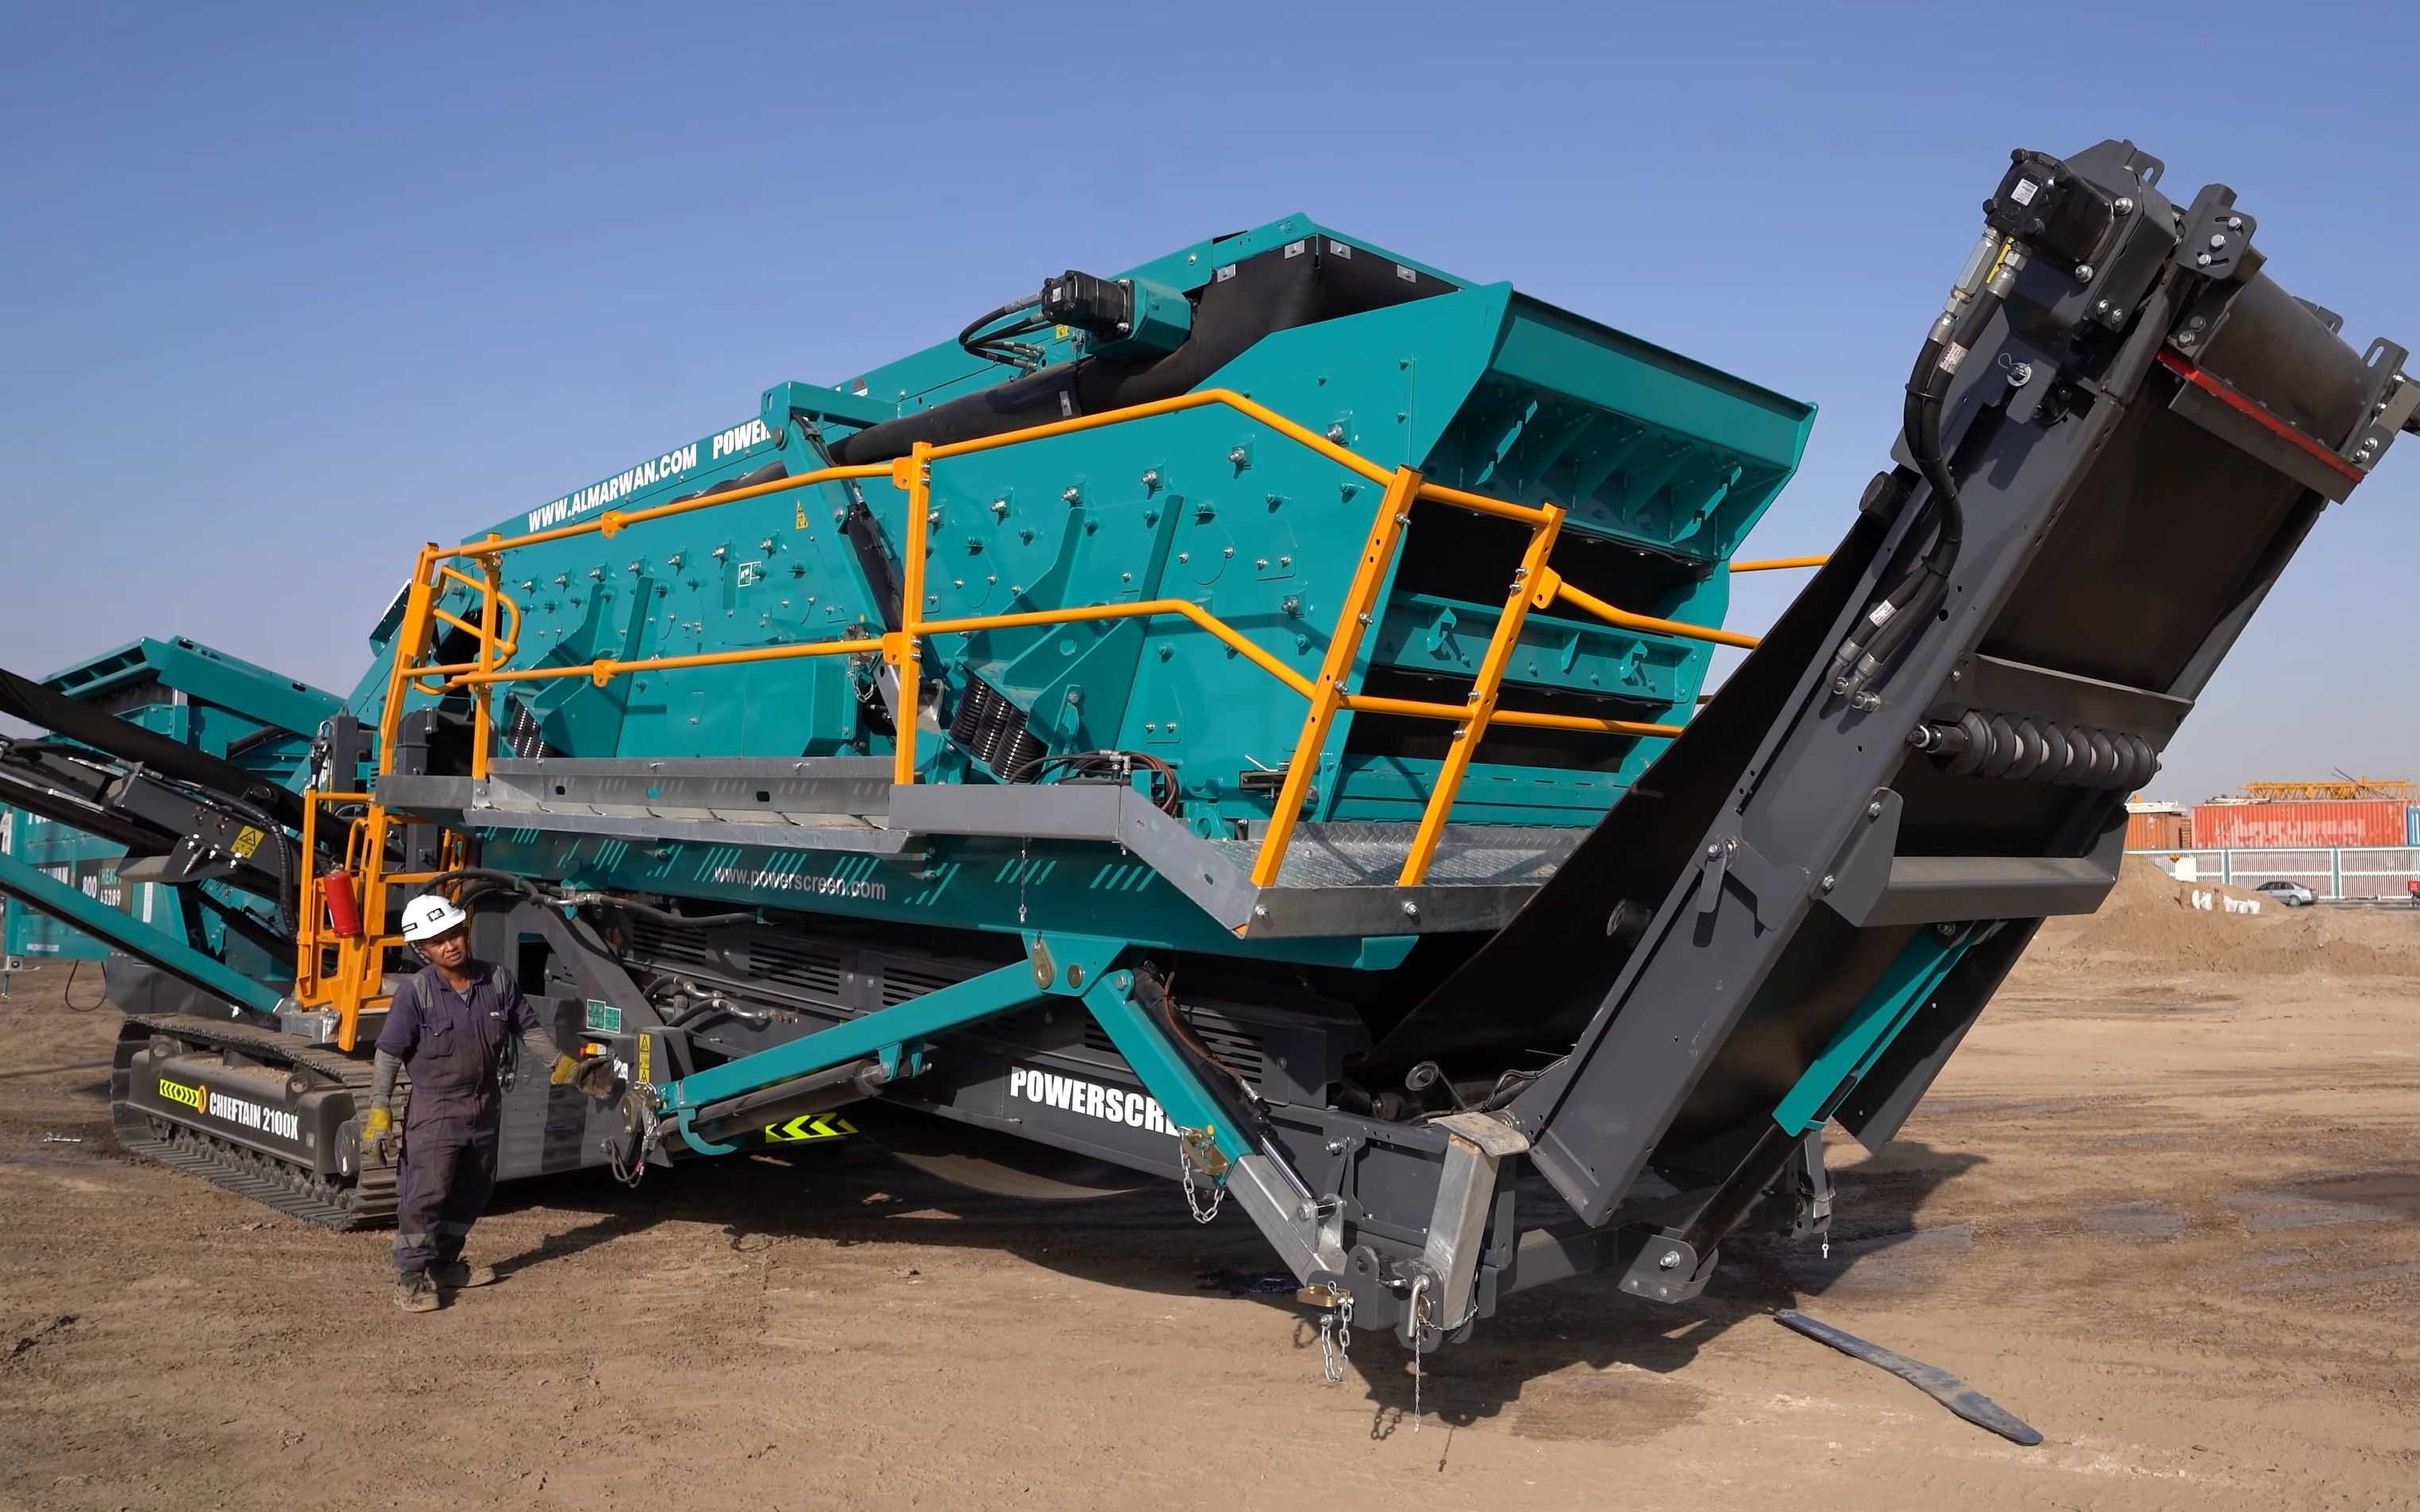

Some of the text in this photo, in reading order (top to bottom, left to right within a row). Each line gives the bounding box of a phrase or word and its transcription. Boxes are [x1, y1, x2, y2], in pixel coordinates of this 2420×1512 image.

[528, 444, 697, 533] WWW.ALMARWAN.COM
[714, 867, 886, 901] www.powerscreen.com
[210, 1092, 299, 1141] CHIEFTAIN 2100X
